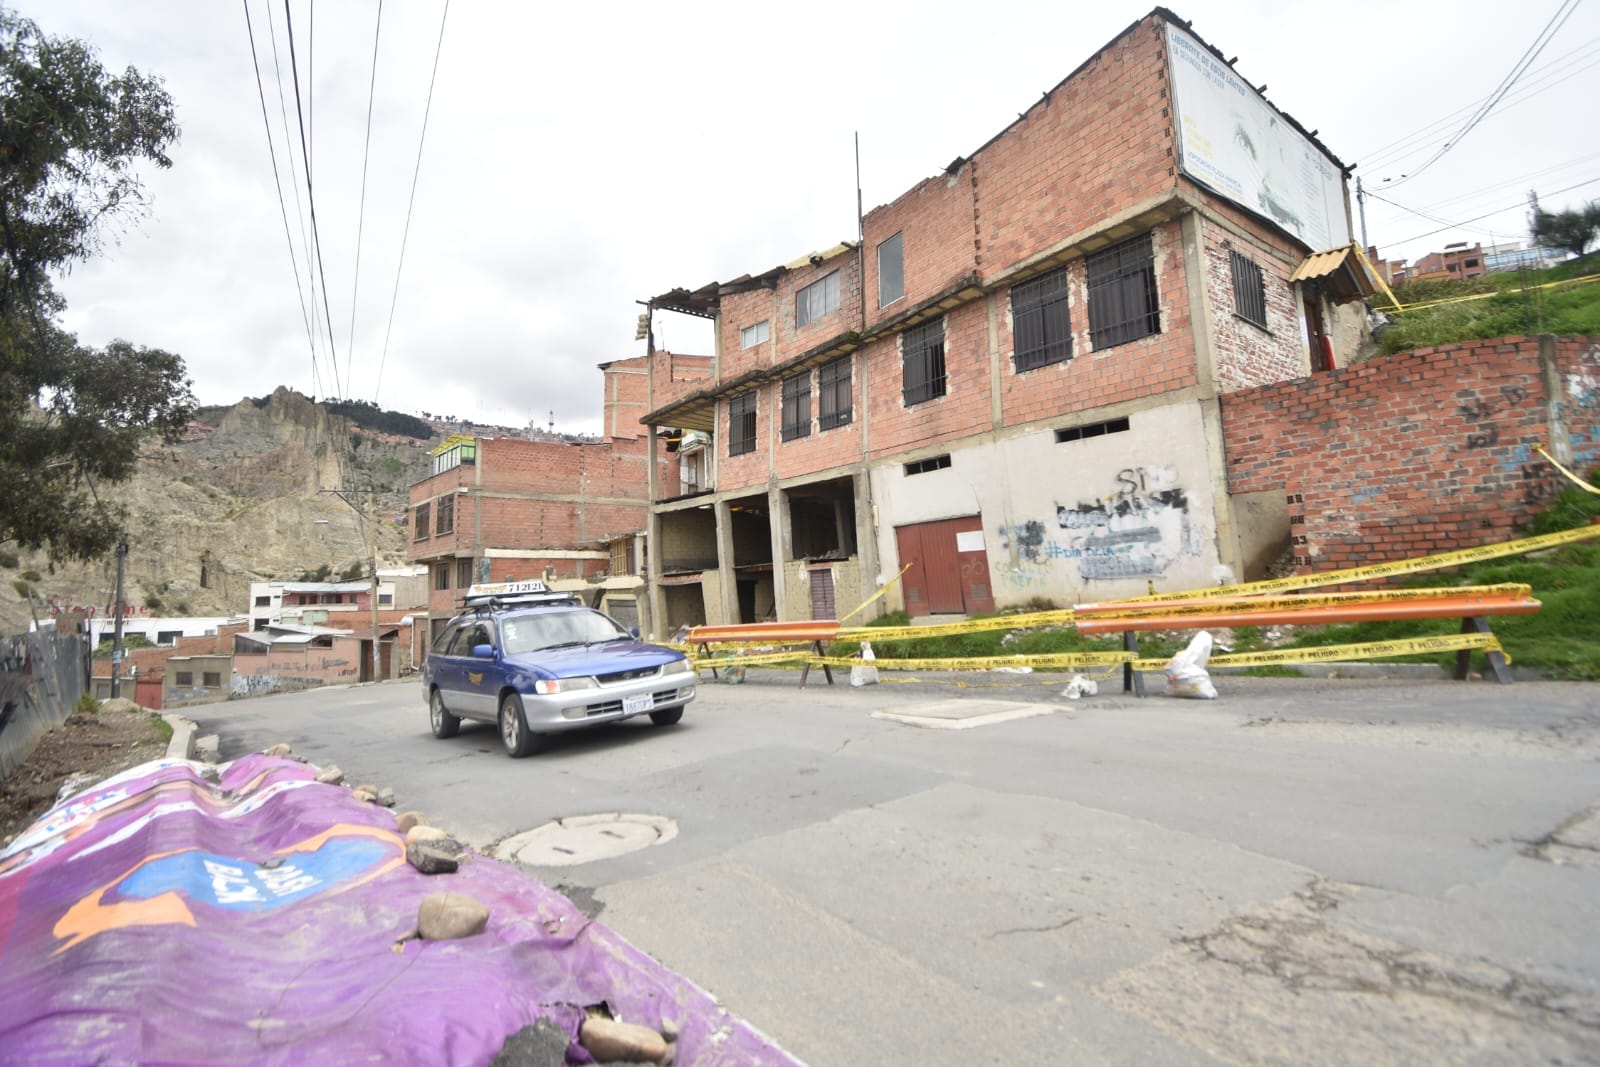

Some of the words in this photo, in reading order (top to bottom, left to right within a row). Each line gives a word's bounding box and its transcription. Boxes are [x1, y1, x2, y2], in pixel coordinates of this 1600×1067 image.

[1210, 588, 1239, 597] PELIGRO
[1260, 582, 1289, 590] PELIGRO
[1311, 574, 1340, 584] PELIGRO
[1362, 567, 1392, 576] PELIGRO
[1413, 558, 1443, 568] PELIGRO
[1465, 549, 1495, 559] PELIGRO
[1279, 598, 1310, 607] PELIGRO
[1332, 594, 1364, 602] PELIGRO
[1386, 590, 1418, 599] PELIGRO
[1031, 657, 1056, 665] PELIGRO
[1254, 654, 1285, 662] PELIGRO
[1308, 650, 1339, 659] PELIGRO
[1363, 645, 1394, 654] PELIGRO
[1418, 639, 1450, 649] PELIGRO
[203, 859, 267, 904] BACK
